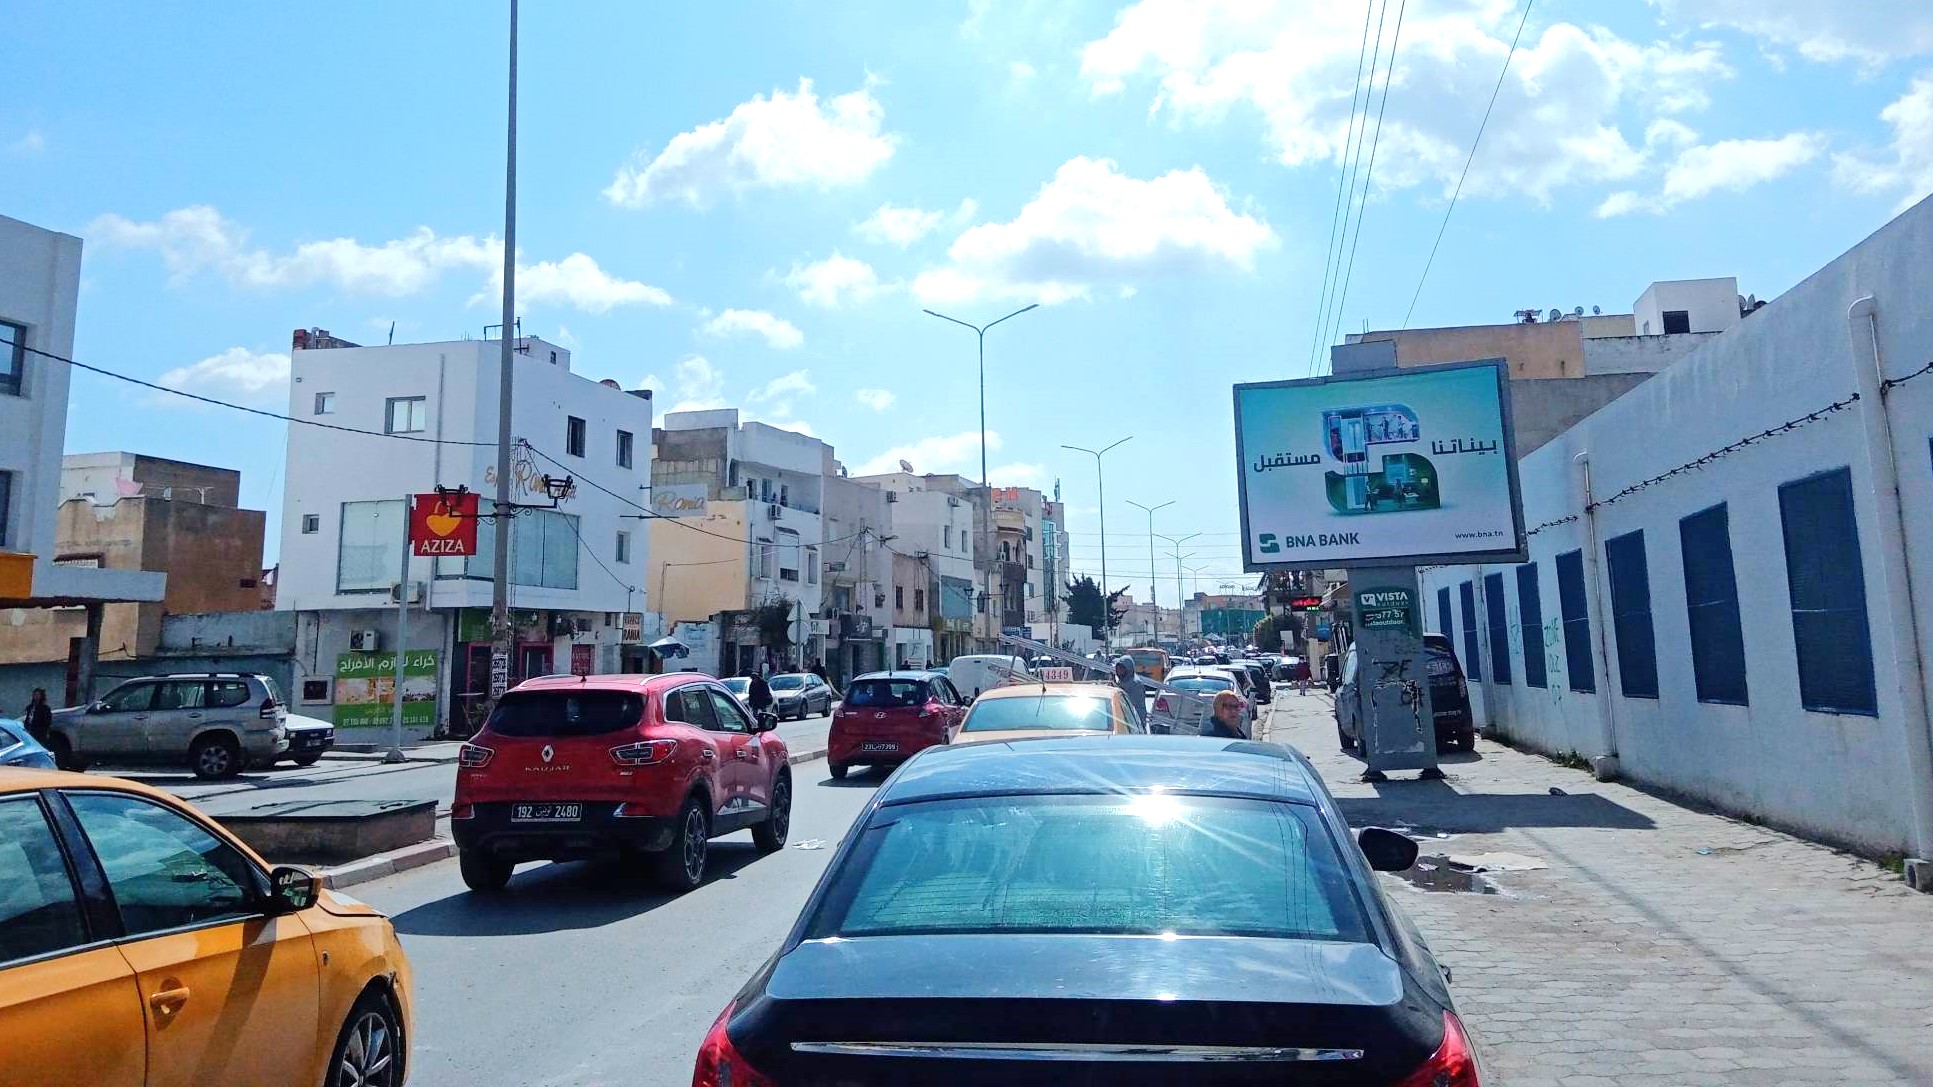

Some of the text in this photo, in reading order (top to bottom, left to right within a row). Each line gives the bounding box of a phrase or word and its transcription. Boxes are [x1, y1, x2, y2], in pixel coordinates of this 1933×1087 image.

[1253, 437, 1497, 473] بيناتنا مستقبل
[1286, 532, 1360, 548] BNA BANK
[1455, 530, 1504, 541] www.bna.tn
[421, 539, 465, 553] AZIZA
[1376, 592, 1408, 602] VISTA
[413, 655, 436, 669] كراء
[517, 805, 533, 817] 192
[554, 805, 579, 818] 2480
